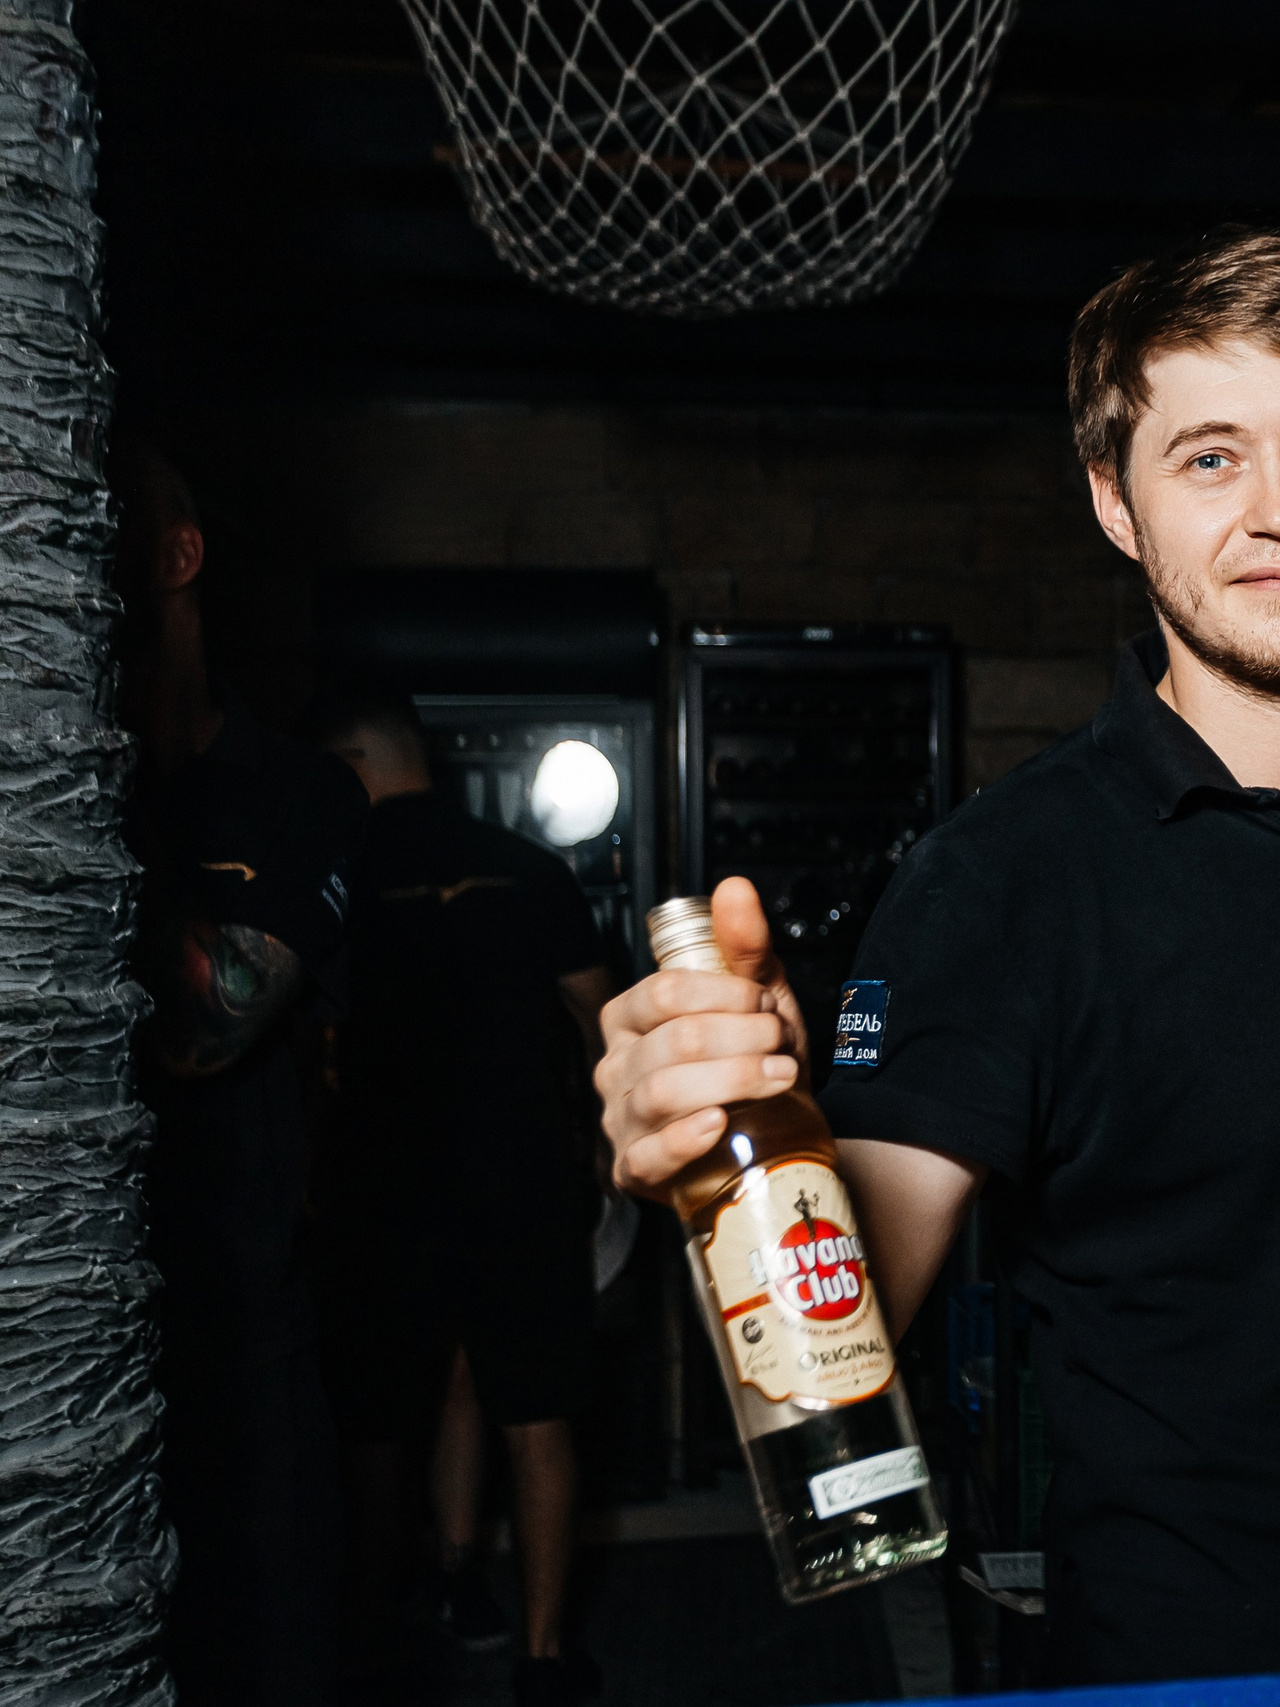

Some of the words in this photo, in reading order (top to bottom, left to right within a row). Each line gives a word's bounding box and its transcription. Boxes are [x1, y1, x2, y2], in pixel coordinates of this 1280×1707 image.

[855, 1048, 877, 1060] ДОМ
[748, 1234, 863, 1287] Havana
[783, 1264, 860, 1312] Club
[799, 1337, 886, 1372] ORIGINAL
